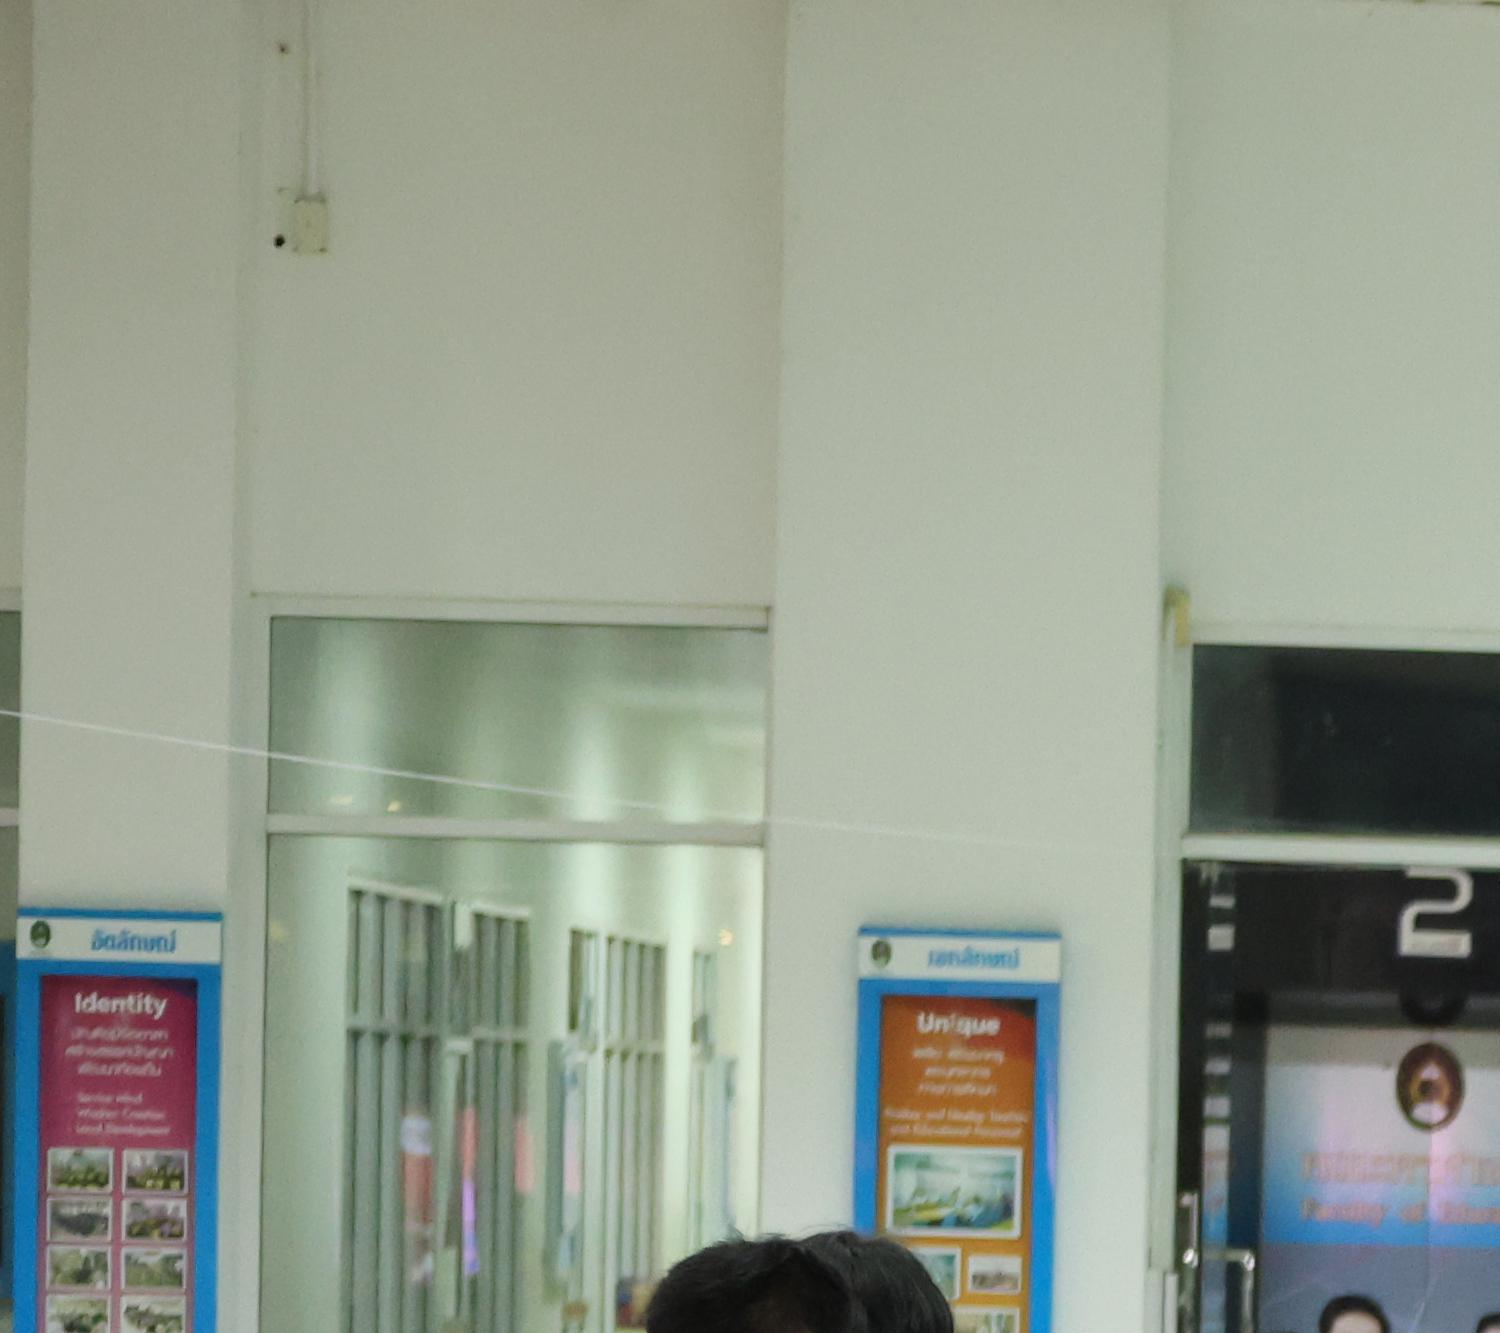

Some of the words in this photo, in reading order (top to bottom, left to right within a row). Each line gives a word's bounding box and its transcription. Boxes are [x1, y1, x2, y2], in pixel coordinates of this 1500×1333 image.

[1399, 866, 1474, 957] 2
[75, 992, 168, 1019] Identity
[917, 1011, 1001, 1038] Unique
